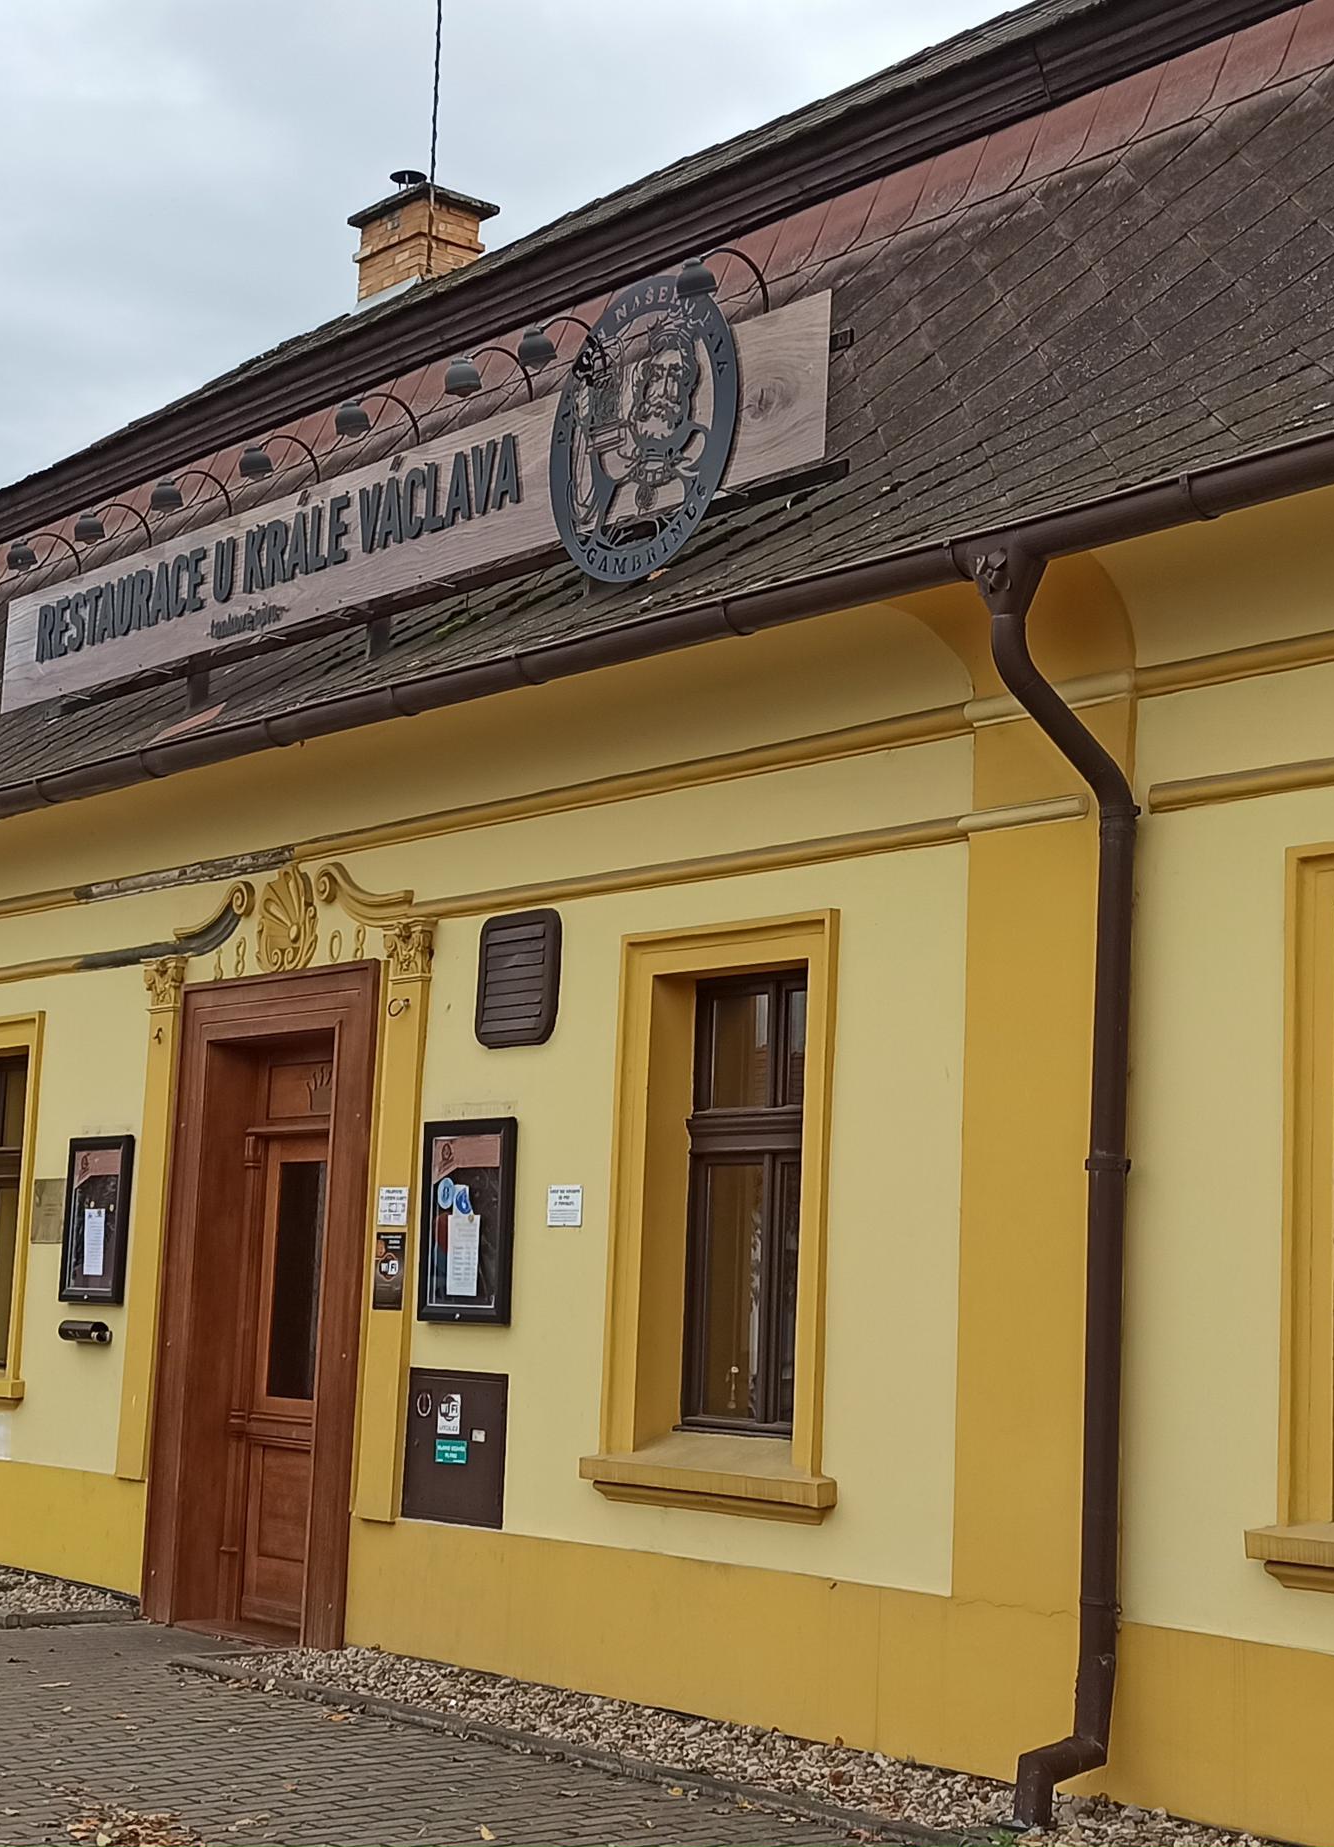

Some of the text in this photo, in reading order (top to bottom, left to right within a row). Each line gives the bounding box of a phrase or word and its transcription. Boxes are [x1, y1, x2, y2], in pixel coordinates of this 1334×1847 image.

[35, 432, 523, 663] RESTAURACE U KRÁLE VÁCLAVA
[585, 484, 708, 575] GAMBRINUS
